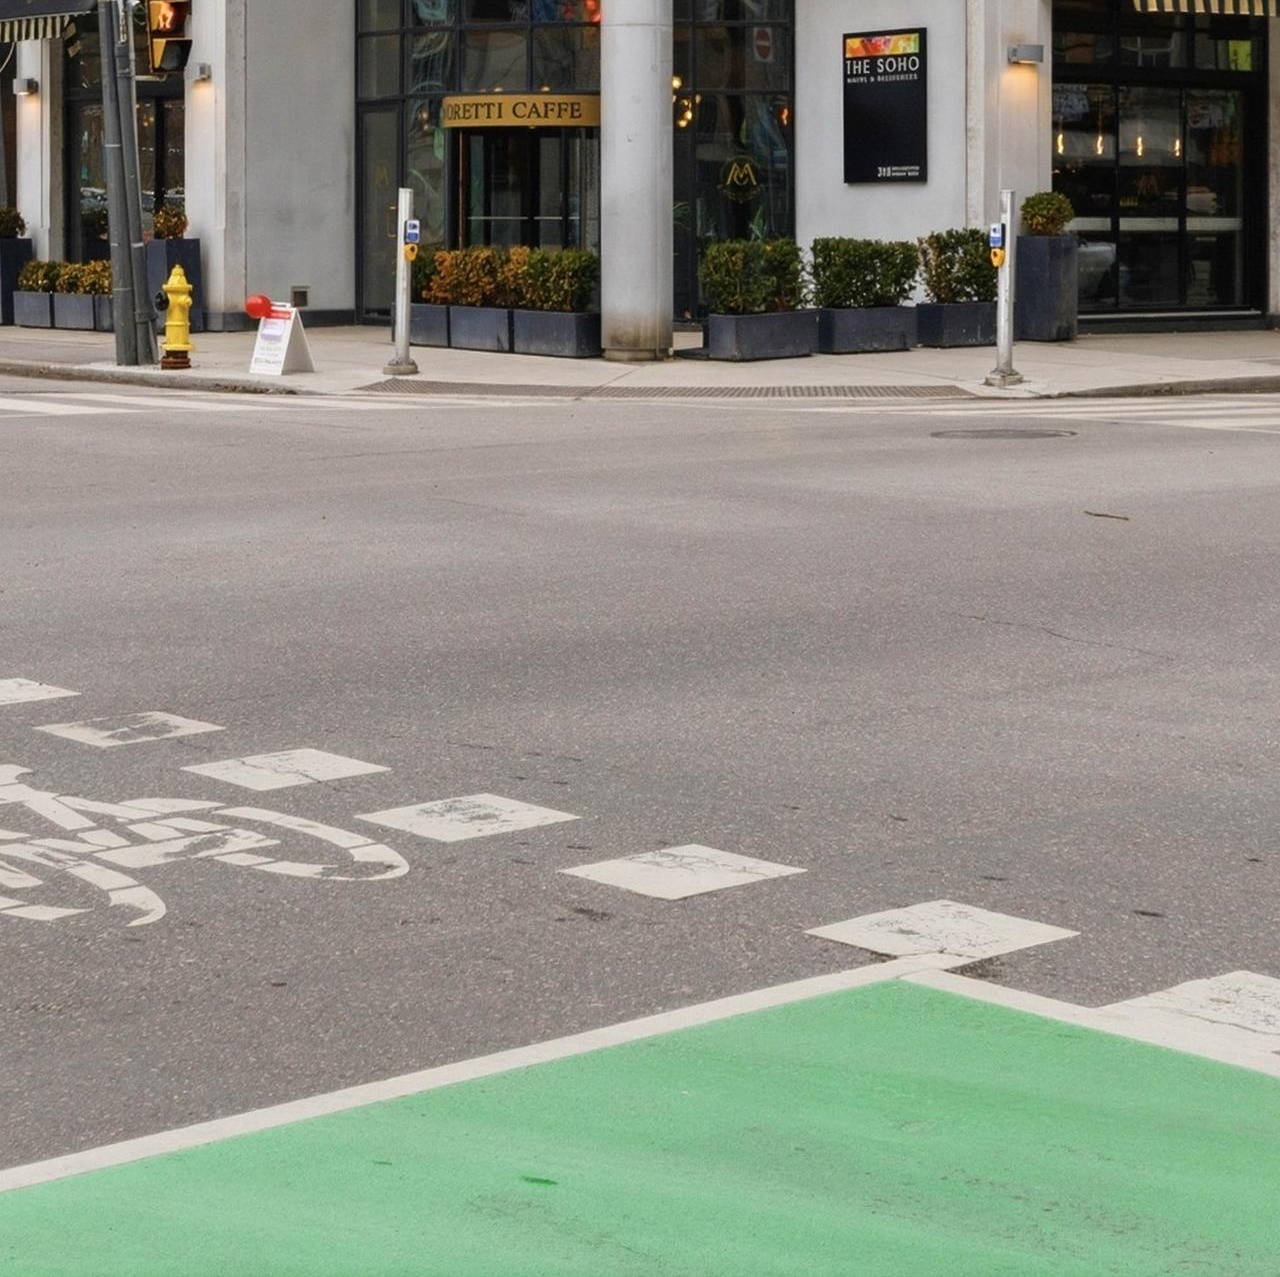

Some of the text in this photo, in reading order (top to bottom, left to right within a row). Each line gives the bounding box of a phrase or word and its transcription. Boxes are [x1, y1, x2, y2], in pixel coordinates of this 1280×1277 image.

[846, 56, 920, 75] THE SOHO
[512, 101, 582, 120] CAFFE
